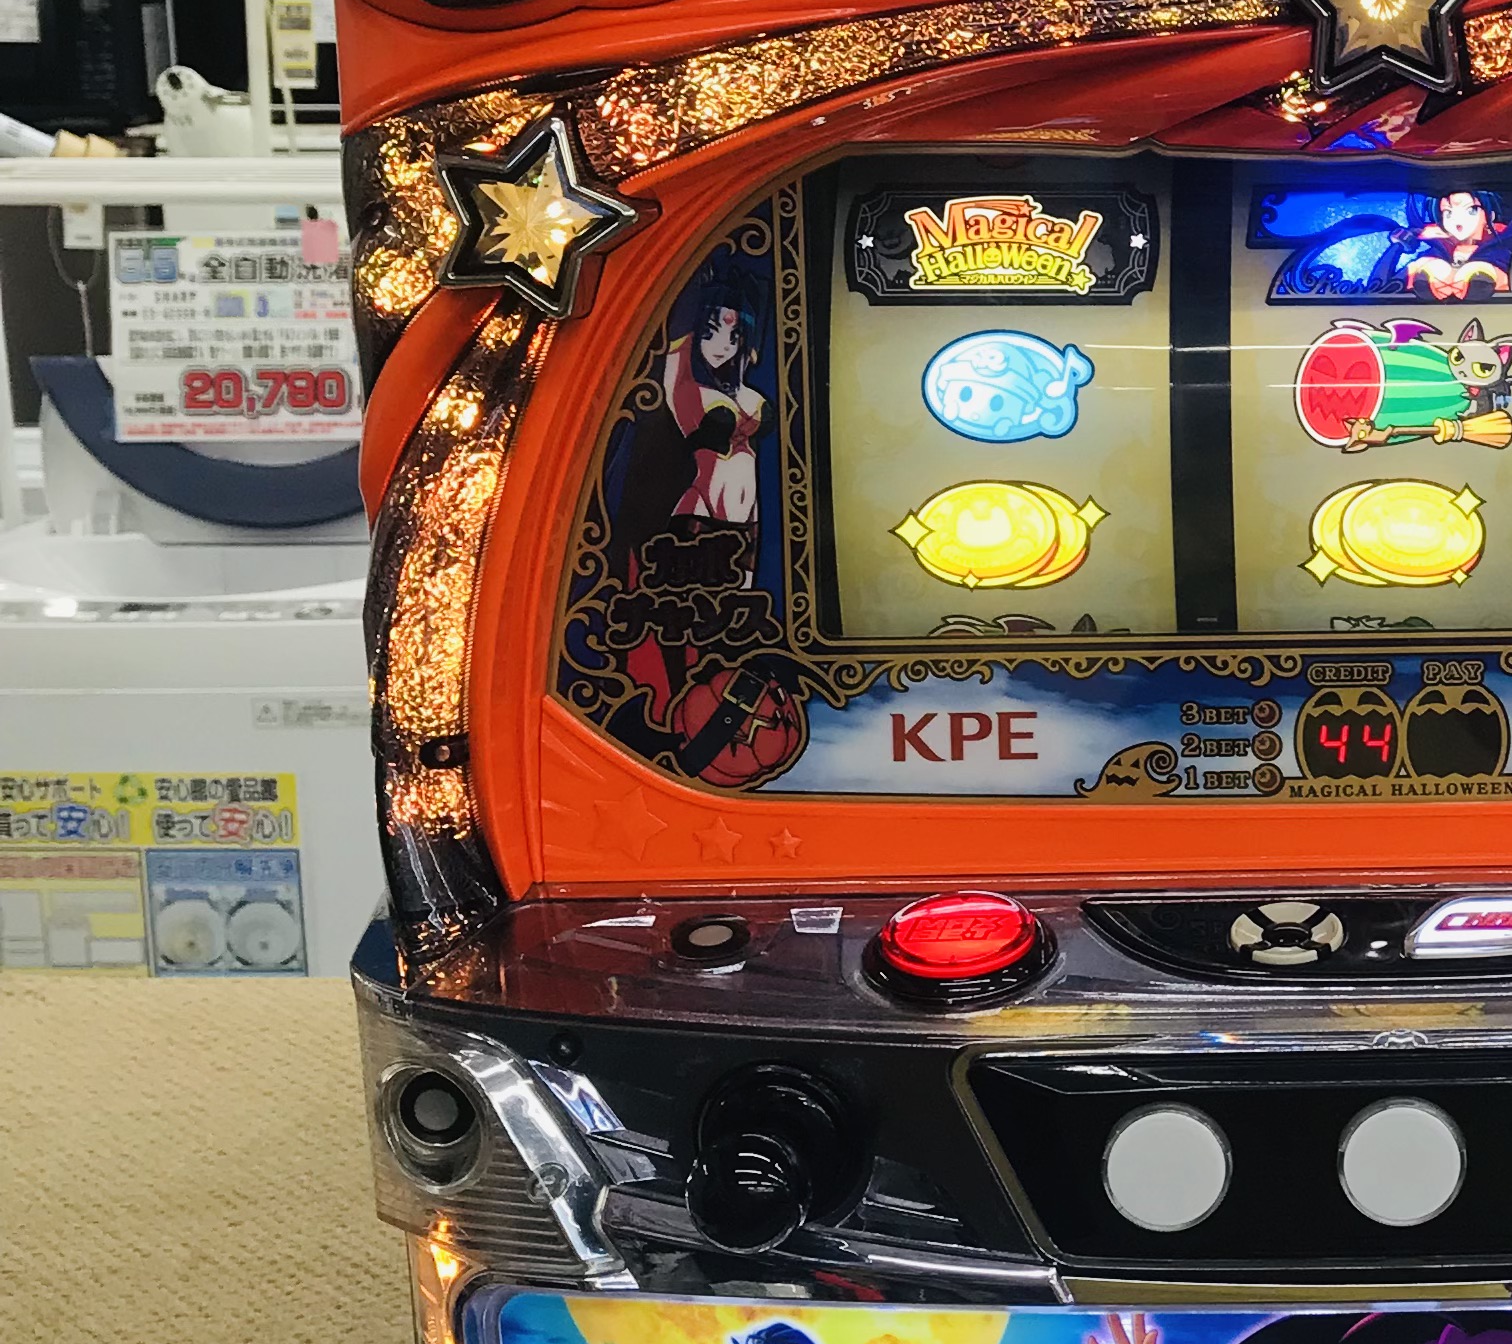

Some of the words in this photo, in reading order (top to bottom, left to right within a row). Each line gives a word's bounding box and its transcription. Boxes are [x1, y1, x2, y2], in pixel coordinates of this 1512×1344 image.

[908, 198, 1100, 259] Magical
[1310, 664, 1391, 684] CREDIT
[1424, 663, 1484, 684] PAY
[891, 712, 1039, 763] KPE
[1289, 783, 1383, 799] MAGICAL
